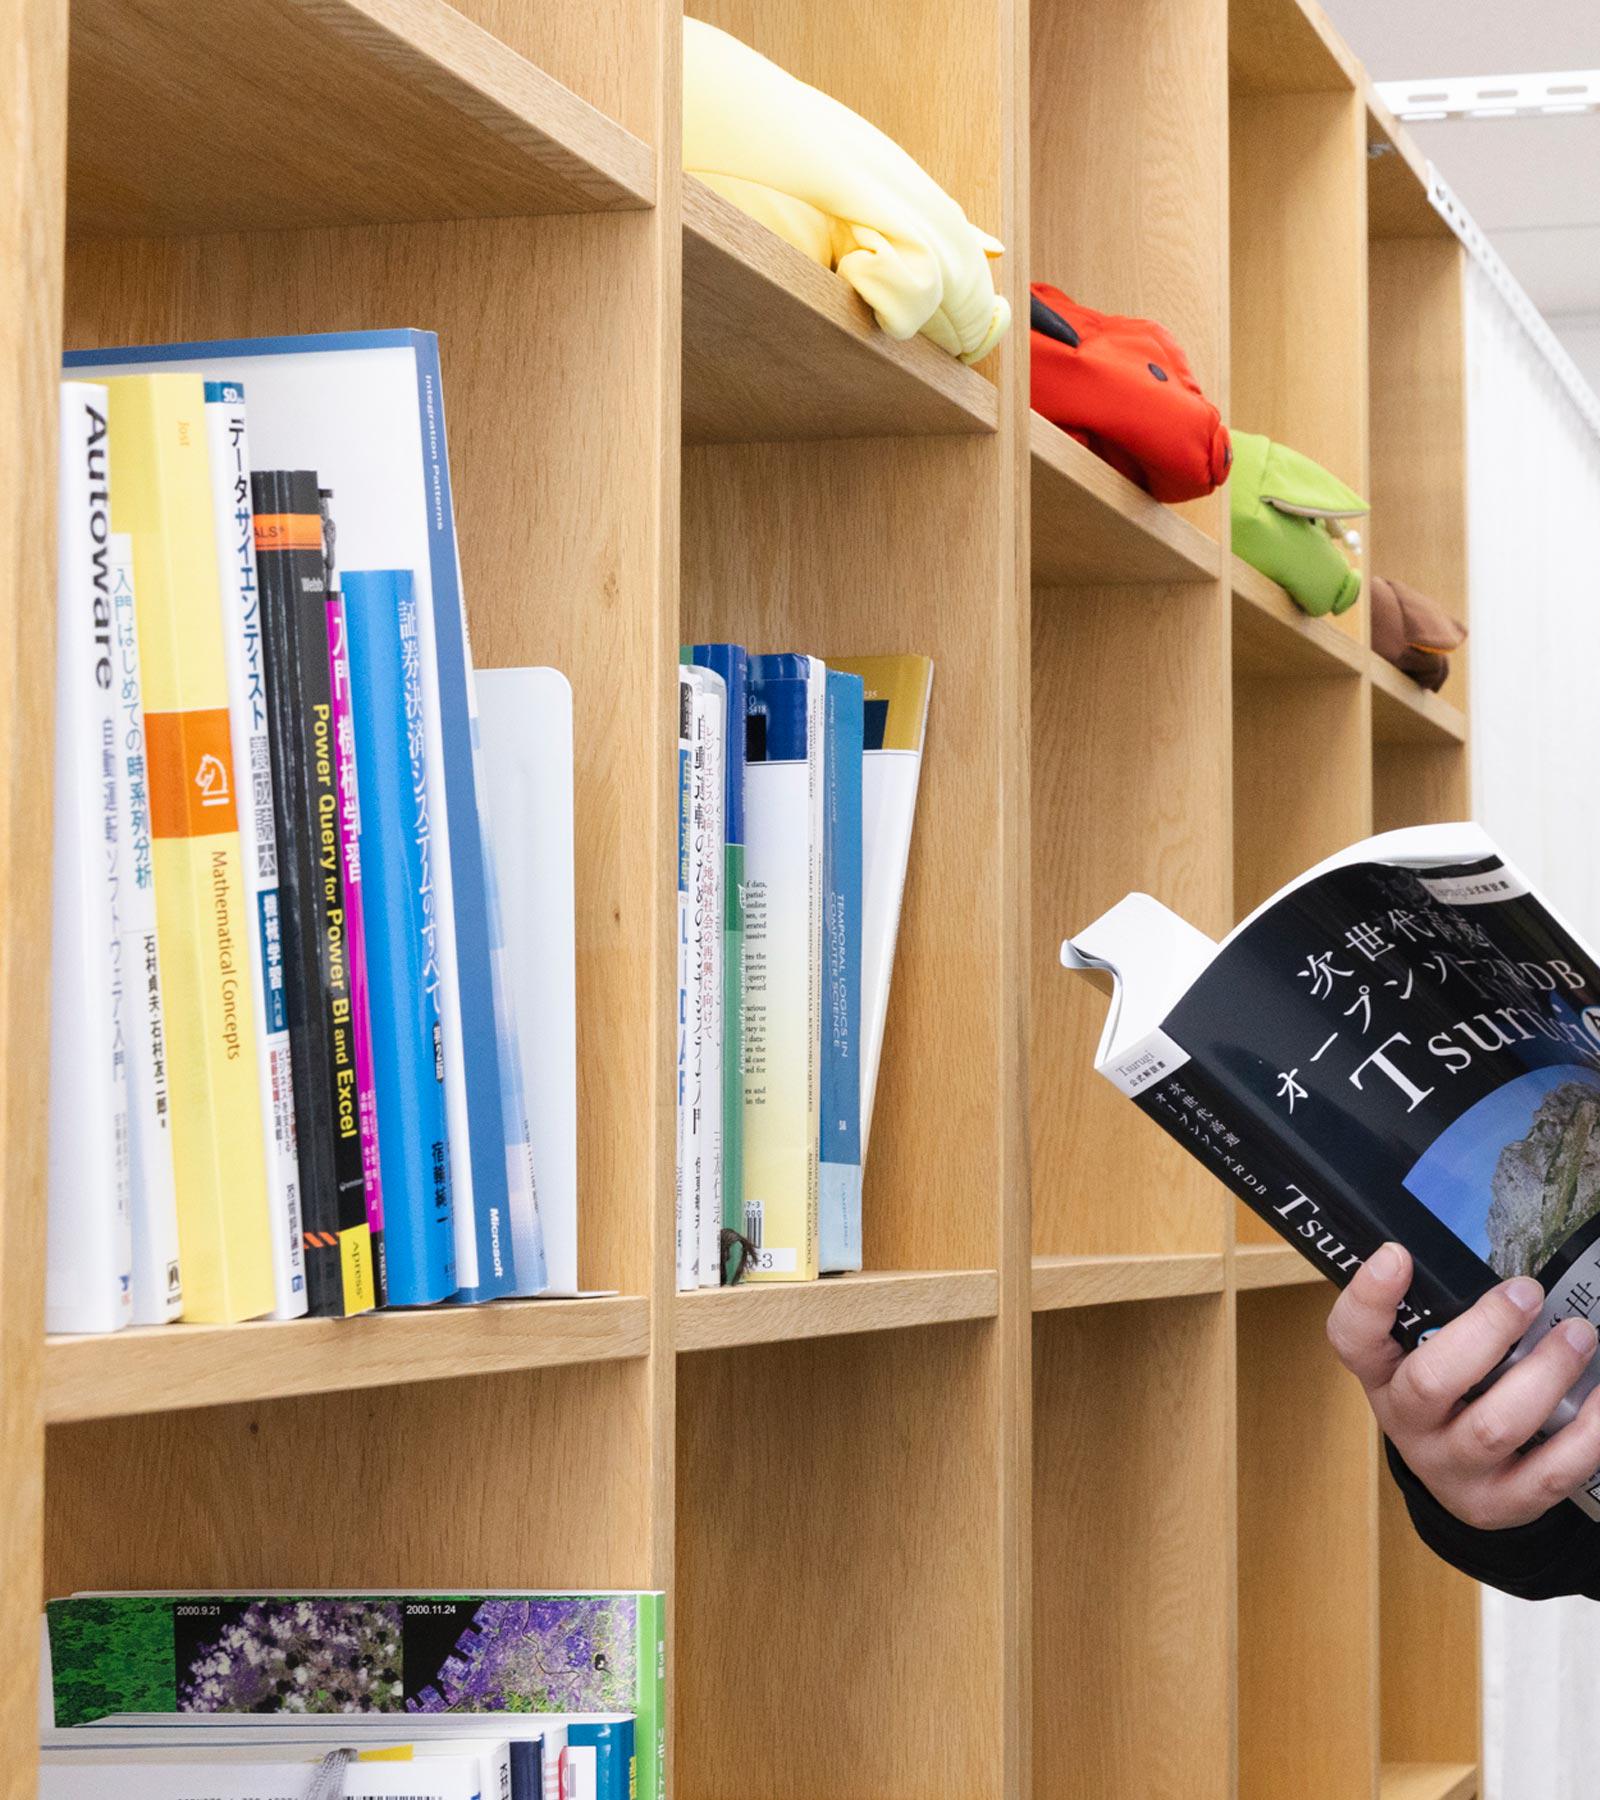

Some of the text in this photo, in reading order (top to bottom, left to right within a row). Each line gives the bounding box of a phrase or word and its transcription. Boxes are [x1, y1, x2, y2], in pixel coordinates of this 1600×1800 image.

[425, 374, 443, 531] Integration Patterns
[85, 403, 112, 690] Autoware
[229, 418, 265, 730] データサイエンティスト
[212, 850, 241, 1061] Mathematical Concepts
[313, 703, 358, 1139] Power Query for Power BI and Excel
[830, 892, 840, 1048] COMPUTER SCIENCE
[836, 894, 849, 1058] TEMPORAL LOGICS IN
[1115, 1049, 1155, 1078] Tsurugi
[1169, 1081, 1241, 1147] 次世代高速
[1154, 1091, 1268, 1196] オープンソースRDB
[490, 1207, 504, 1278] Microsoft
[176, 1605, 221, 1616] 2000.9.21
[405, 1604, 457, 1615] 2000.11.24
